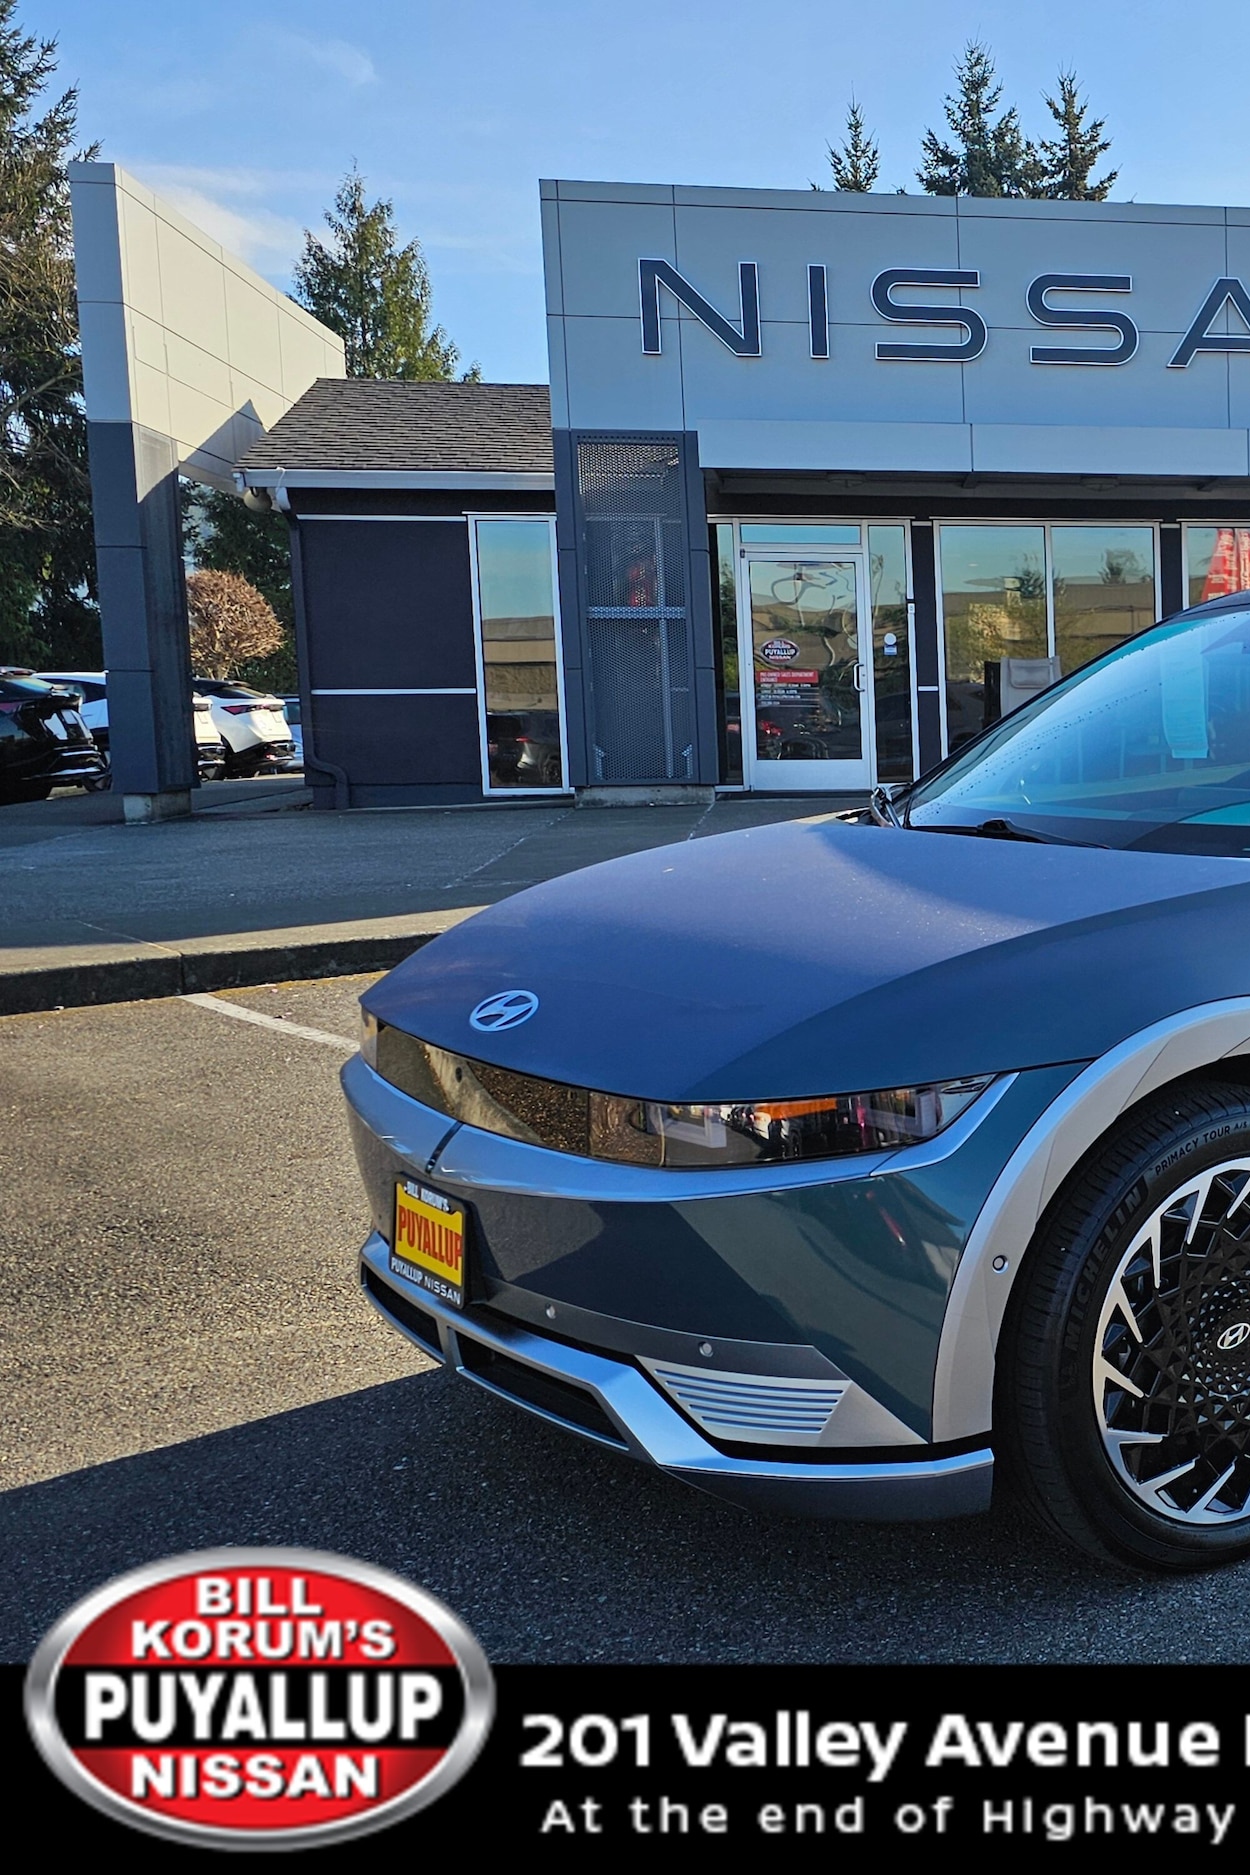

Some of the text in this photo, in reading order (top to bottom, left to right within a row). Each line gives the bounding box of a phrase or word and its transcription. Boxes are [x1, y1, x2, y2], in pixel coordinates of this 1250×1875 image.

[1155, 1138, 1199, 1176] PRIMACY
[1202, 1124, 1232, 1144] TOUR
[398, 1205, 463, 1271] PUYALLUP
[391, 1257, 461, 1305] PUYALLUP NISSAN
[1064, 1184, 1143, 1352] MICHELIN
